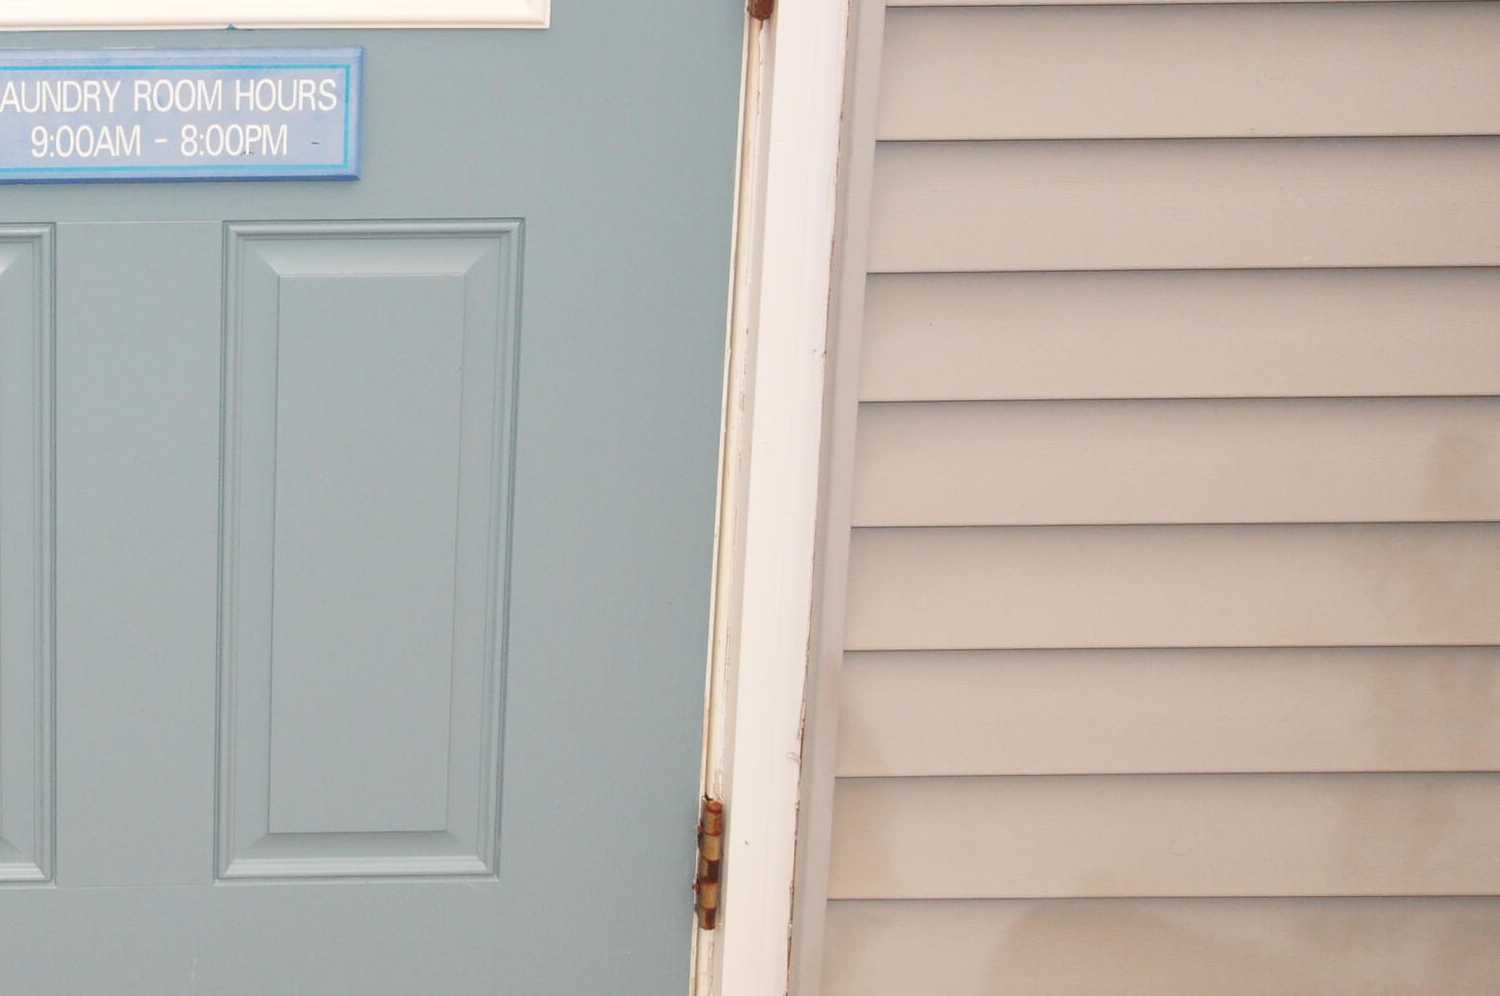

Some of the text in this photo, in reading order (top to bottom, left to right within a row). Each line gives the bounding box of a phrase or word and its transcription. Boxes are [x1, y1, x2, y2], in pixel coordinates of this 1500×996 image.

[133, 78, 223, 112] ROOM
[235, 77, 338, 112] HOURS
[30, 124, 141, 158] 9:00AM
[179, 123, 288, 157] 8:00PM
